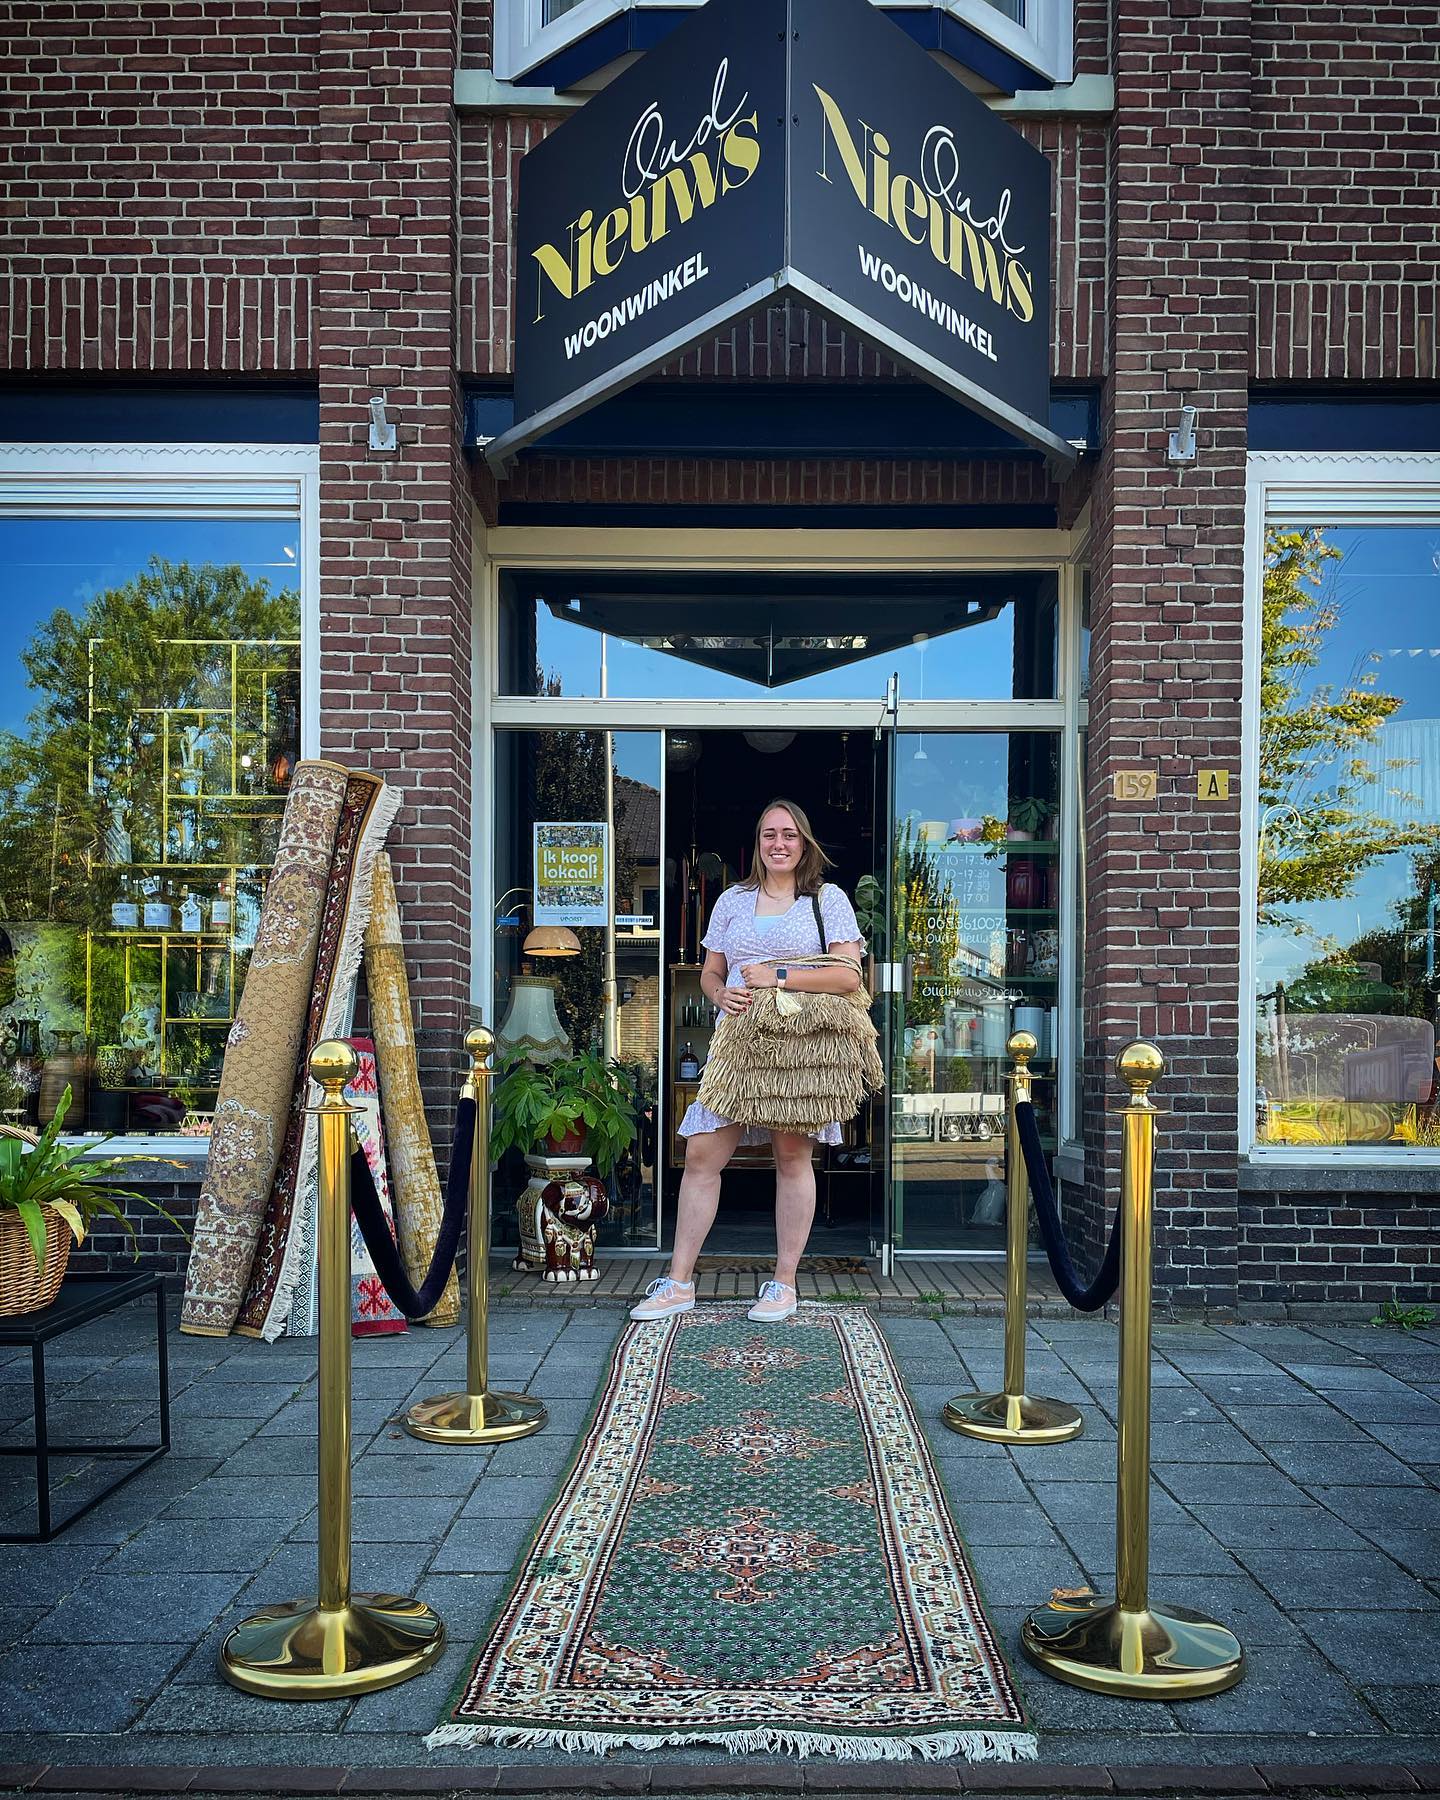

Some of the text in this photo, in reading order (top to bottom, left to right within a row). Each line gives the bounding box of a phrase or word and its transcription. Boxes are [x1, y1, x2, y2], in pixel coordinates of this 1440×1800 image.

[622, 57, 749, 199] Oud
[532, 110, 761, 324] Nieuws
[812, 83, 1035, 323] Nieuws
[921, 125, 1026, 254] Oud
[563, 252, 709, 360] WOONWINKEL
[858, 244, 998, 362] WOONWINKEL
[1117, 774, 1152, 798] 159
[1207, 774, 1219, 797] A
[543, 850, 598, 865] Ik koop
[543, 864, 597, 879] lokaal!
